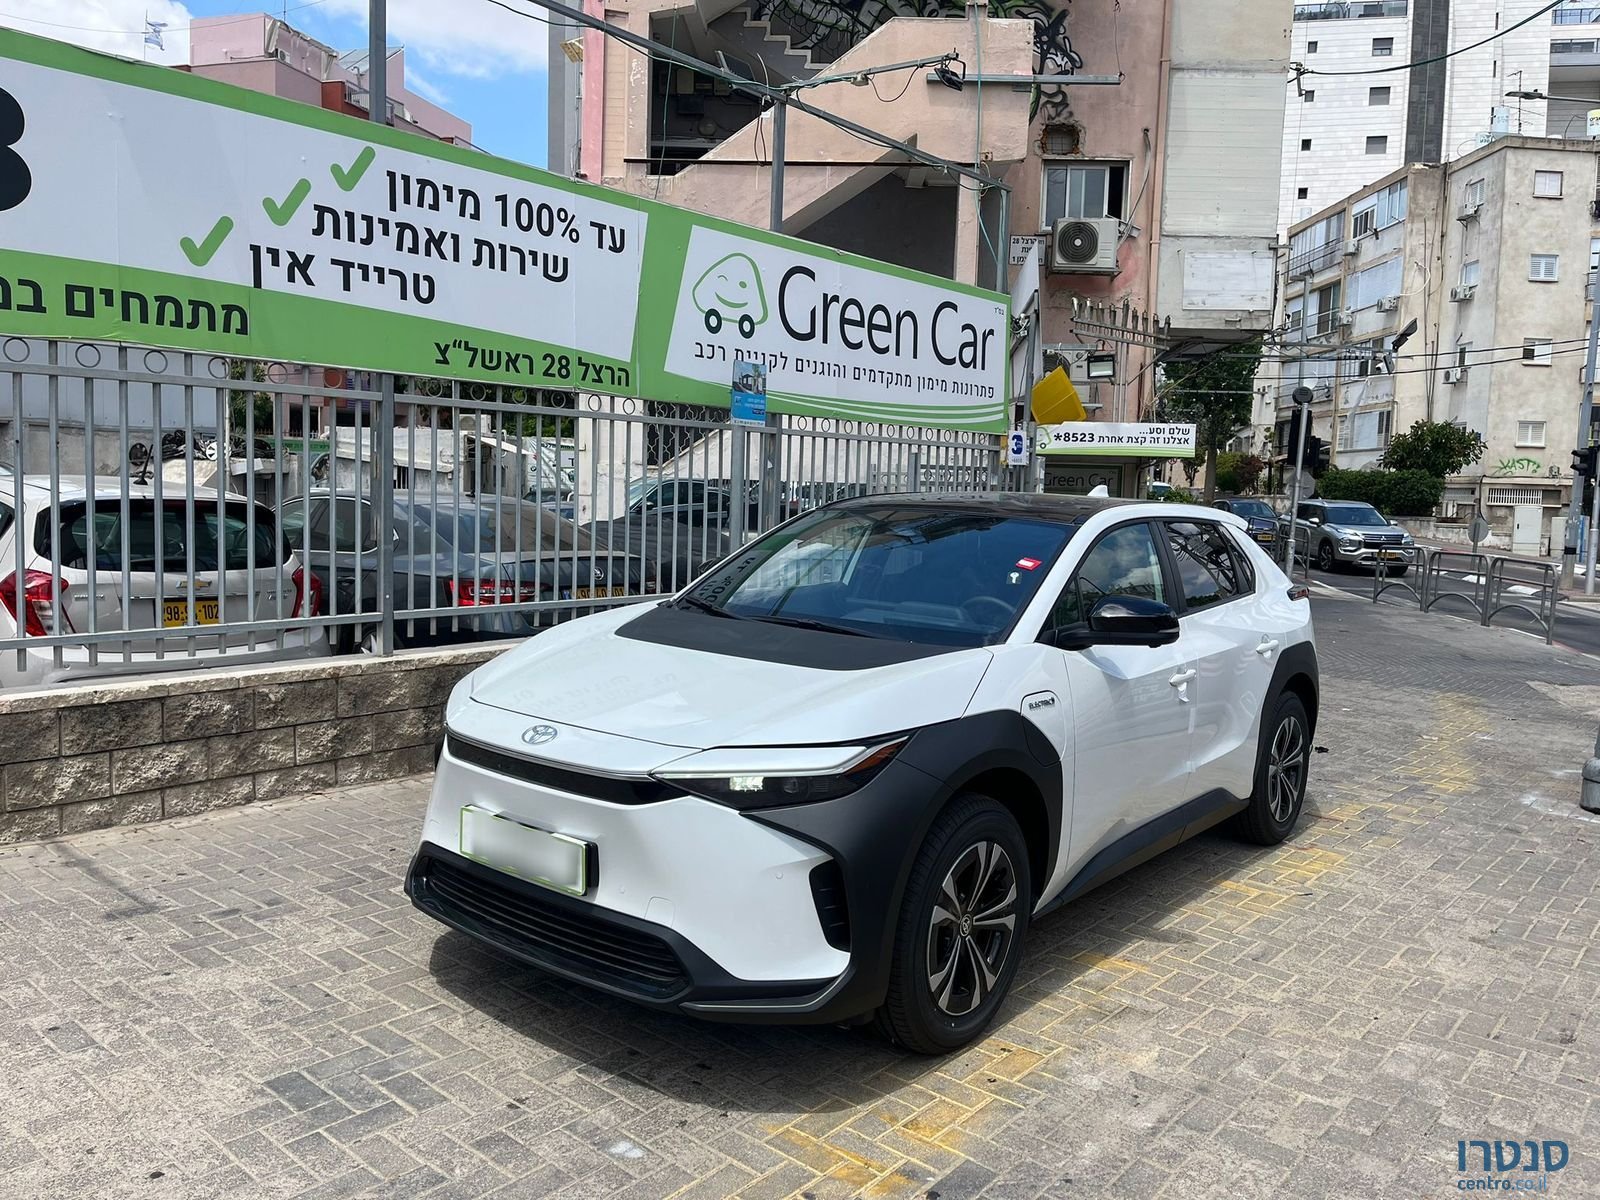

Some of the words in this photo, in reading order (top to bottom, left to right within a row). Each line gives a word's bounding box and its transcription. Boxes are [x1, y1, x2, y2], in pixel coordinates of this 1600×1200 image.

[386, 170, 481, 221] מימון
[495, 193, 580, 244] 100%
[311, 204, 460, 263] ואמינות
[590, 220, 625, 254] עד
[249, 243, 316, 288] אין
[472, 238, 569, 283] שירות
[330, 258, 436, 304] טרייד
[64, 283, 249, 336] מתמחים
[778, 265, 919, 360] Green
[931, 300, 995, 371] Car
[694, 341, 726, 362] רכב
[541, 352, 571, 380] 28
[577, 356, 630, 388] הרצל
[795, 357, 847, 379] והוגנים
[852, 366, 912, 389] מתקדמים
[917, 376, 948, 393] מימון
[951, 381, 995, 399] פתרונות
[1097, 435, 1124, 444] אחרת
[1126, 435, 1147, 446] קצת
[1149, 436, 1161, 444] זה
[1162, 435, 1190, 445] אצלנו
[1168, 426, 1190, 436] שלם
